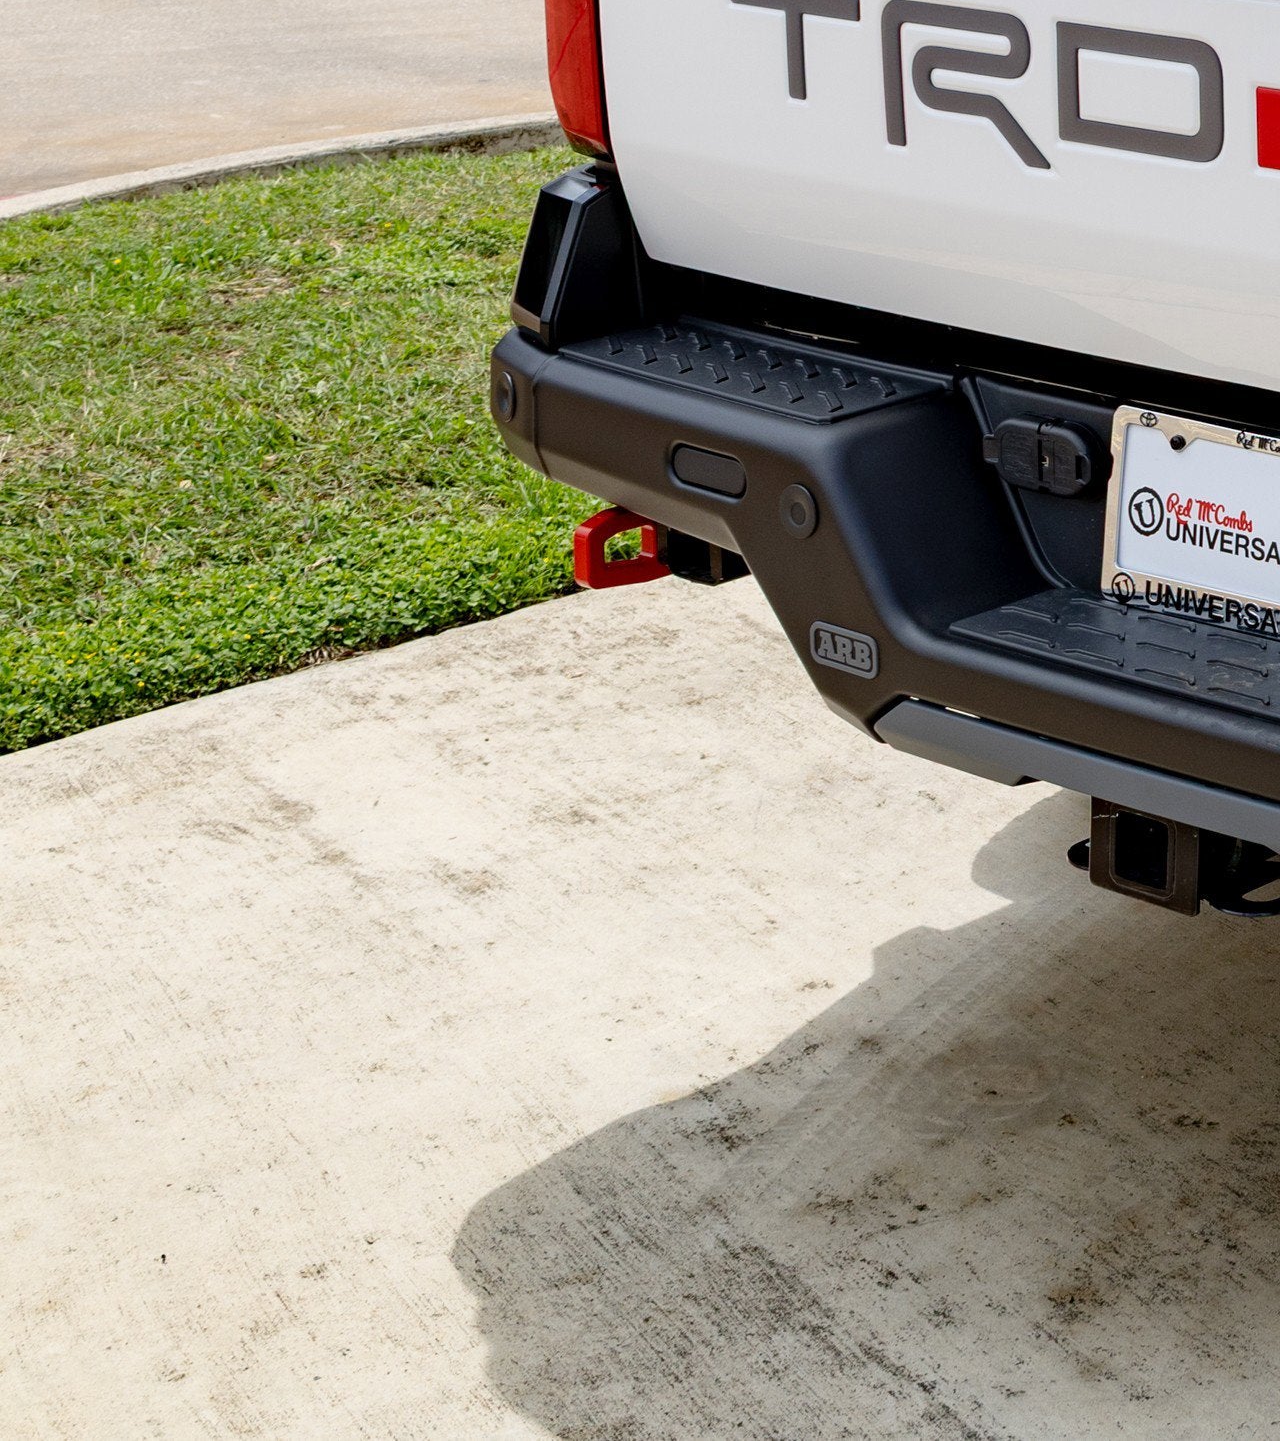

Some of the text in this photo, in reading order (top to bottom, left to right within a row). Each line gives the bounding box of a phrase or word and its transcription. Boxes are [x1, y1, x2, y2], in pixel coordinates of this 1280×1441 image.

[1236, 428, 1254, 450] Red
[1166, 492, 1253, 533] Red McCombs
[817, 630, 873, 671] ARB
